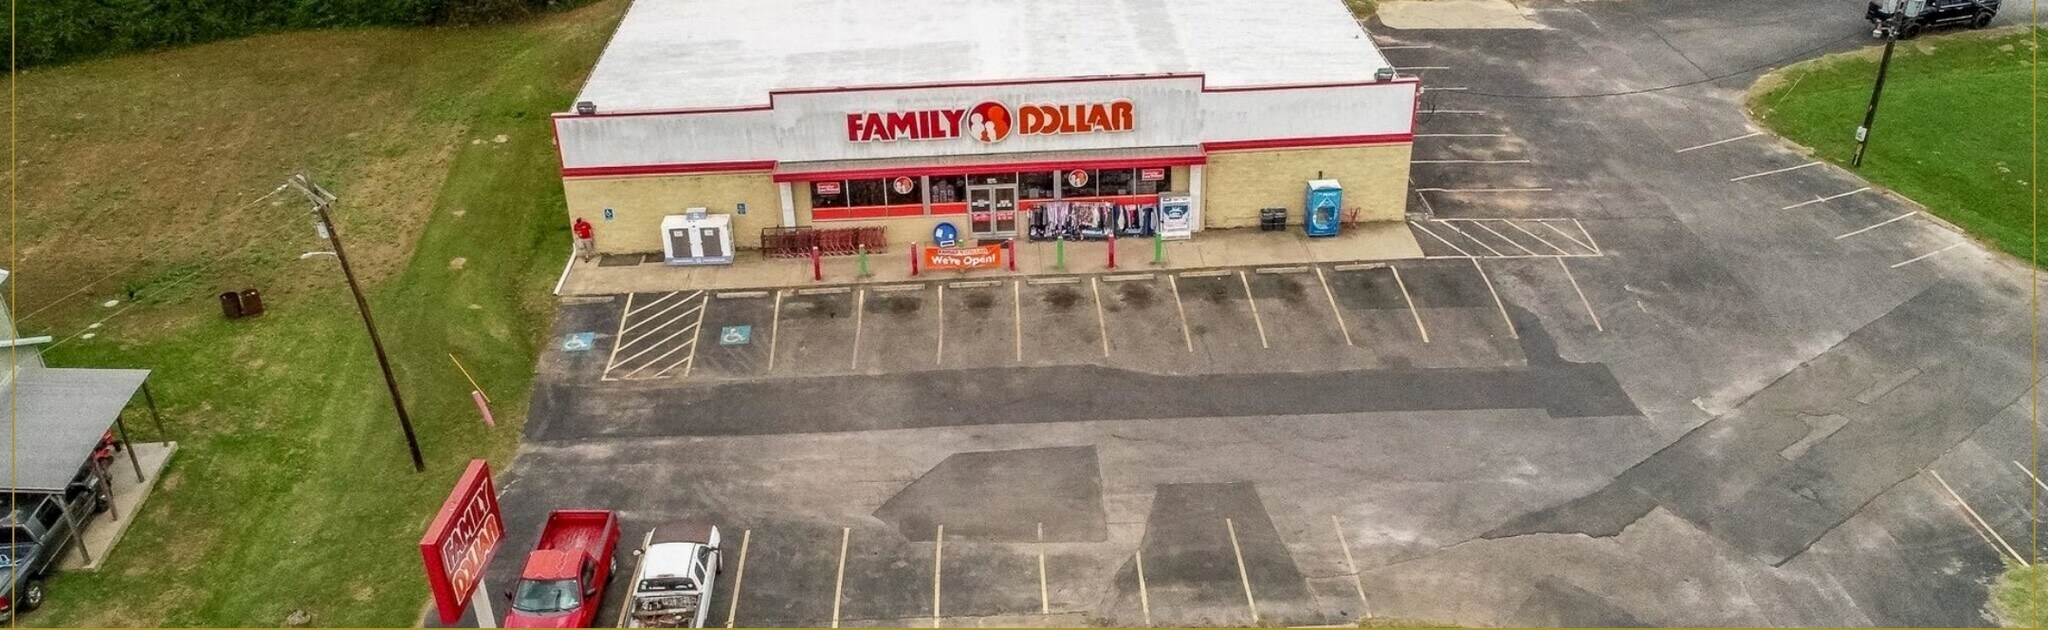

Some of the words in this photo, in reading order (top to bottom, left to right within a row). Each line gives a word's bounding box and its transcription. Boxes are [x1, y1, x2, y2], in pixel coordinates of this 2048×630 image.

[845, 109, 967, 142] FAMILY
[1017, 99, 1136, 136] DOLLAR
[931, 255, 961, 265] We're
[963, 254, 996, 266] Open!
[443, 477, 490, 574] FAMILY
[452, 513, 500, 606] DOLLAR
